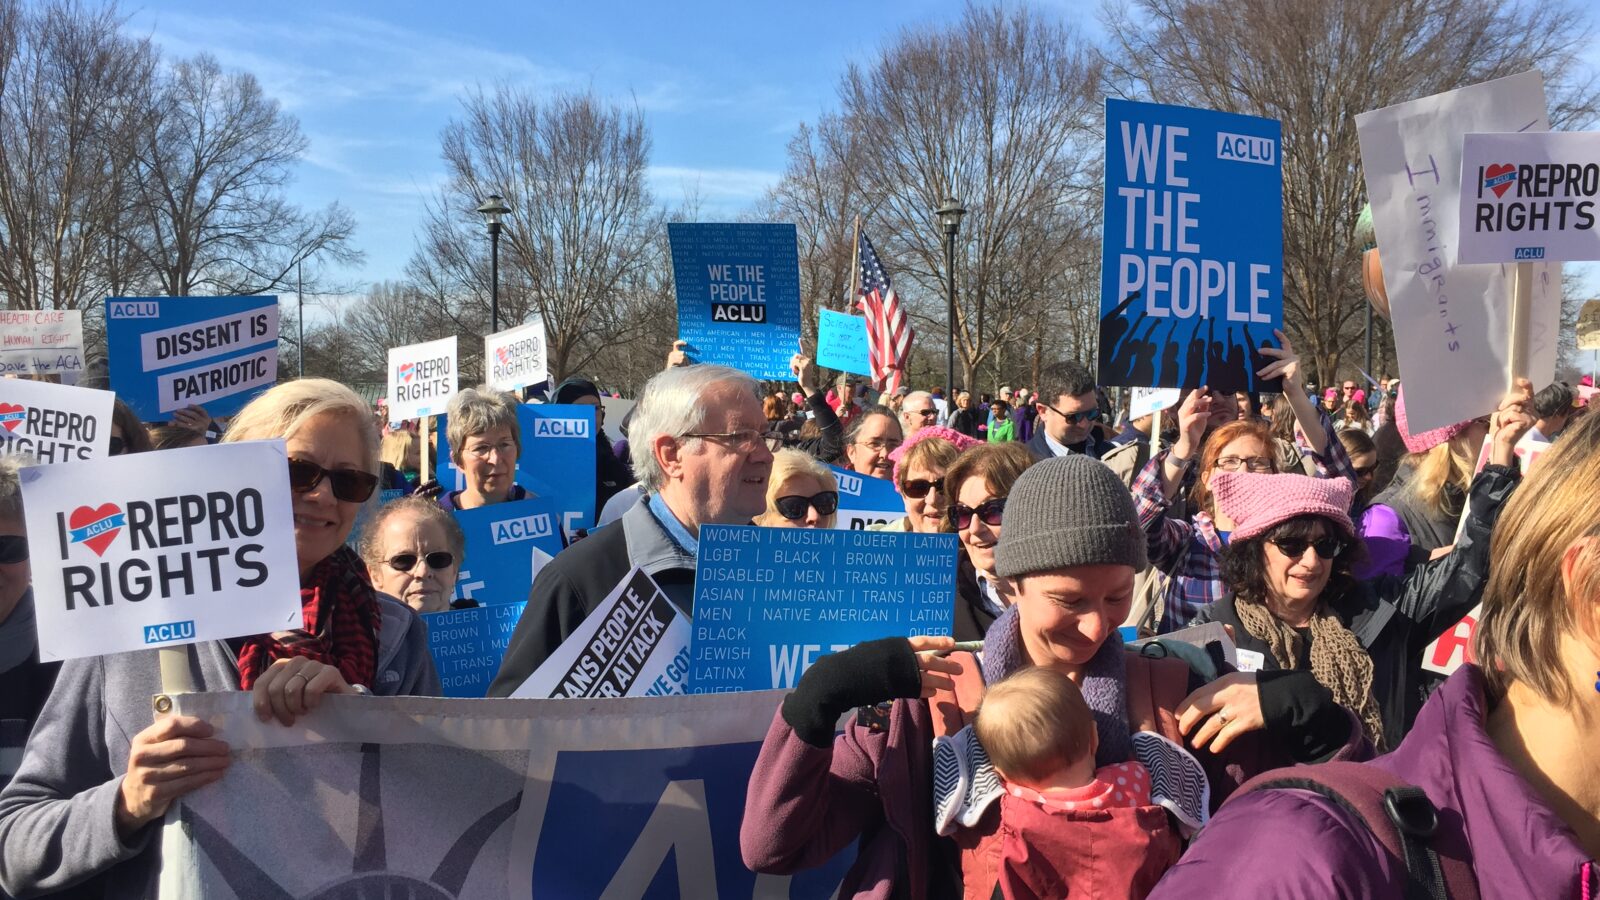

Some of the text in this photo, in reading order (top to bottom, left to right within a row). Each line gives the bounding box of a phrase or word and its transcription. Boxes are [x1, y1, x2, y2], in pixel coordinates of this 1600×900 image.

[1120, 120, 1189, 187] WE
[1220, 136, 1272, 162] ACLU
[1478, 163, 1600, 198] I REPRO
[1494, 175, 1510, 184] ACLU
[1118, 187, 1200, 254] THE
[1476, 201, 1595, 232] RIGHTS
[1516, 248, 1544, 258] ACLU
[708, 264, 765, 282] WE THE
[710, 284, 766, 302] PEOPLE
[1118, 254, 1272, 324] PEOPLE
[34, 312, 64, 324] CARE
[113, 304, 156, 316] ACLU
[714, 305, 764, 321] ACLU
[4, 334, 71, 346] HUMAN RIGHT
[156, 314, 268, 361] DISSENT IS
[508, 336, 538, 358] REPRO
[32, 356, 50, 370] the
[56, 355, 82, 370] ACA
[416, 356, 450, 380] REPRO
[494, 354, 540, 378] RIGHTS
[173, 356, 268, 401] PATRIOTIC
[396, 378, 450, 404] RIGHTS
[26, 406, 96, 442] REPRO
[538, 421, 586, 436] ACLU
[0, 436, 93, 464] IGHTS
[56, 488, 265, 560] I REPRO
[86, 519, 113, 537] ACLU
[497, 515, 548, 541] ACLU
[706, 528, 954, 549] WOMEN MUSLIM QUEER LATINX
[704, 548, 952, 568] LGBT BLACK BROWN WHITE
[62, 544, 268, 611] RIGHTS
[703, 568, 952, 585] DISABLED MEN TRANS MUSLIM
[700, 588, 952, 604] ASIAN IMMIGRANT TRANS LGBT
[436, 605, 524, 626] QUEER LATI
[700, 608, 950, 622] MEN NATIVE AMERICAN LATINX
[146, 622, 193, 642] ACLU
[432, 626, 479, 643] BROWN
[551, 654, 600, 698] ANS
[590, 586, 644, 664] PEOPLE
[698, 627, 746, 640] BLACK
[432, 642, 474, 658] TRANS
[612, 610, 664, 688] ATTACK
[696, 646, 750, 660] JEWISH
[453, 655, 494, 671] TRANS
[666, 645, 690, 682] GOT
[695, 666, 745, 680] LATINX
[442, 673, 480, 689] RICAN
